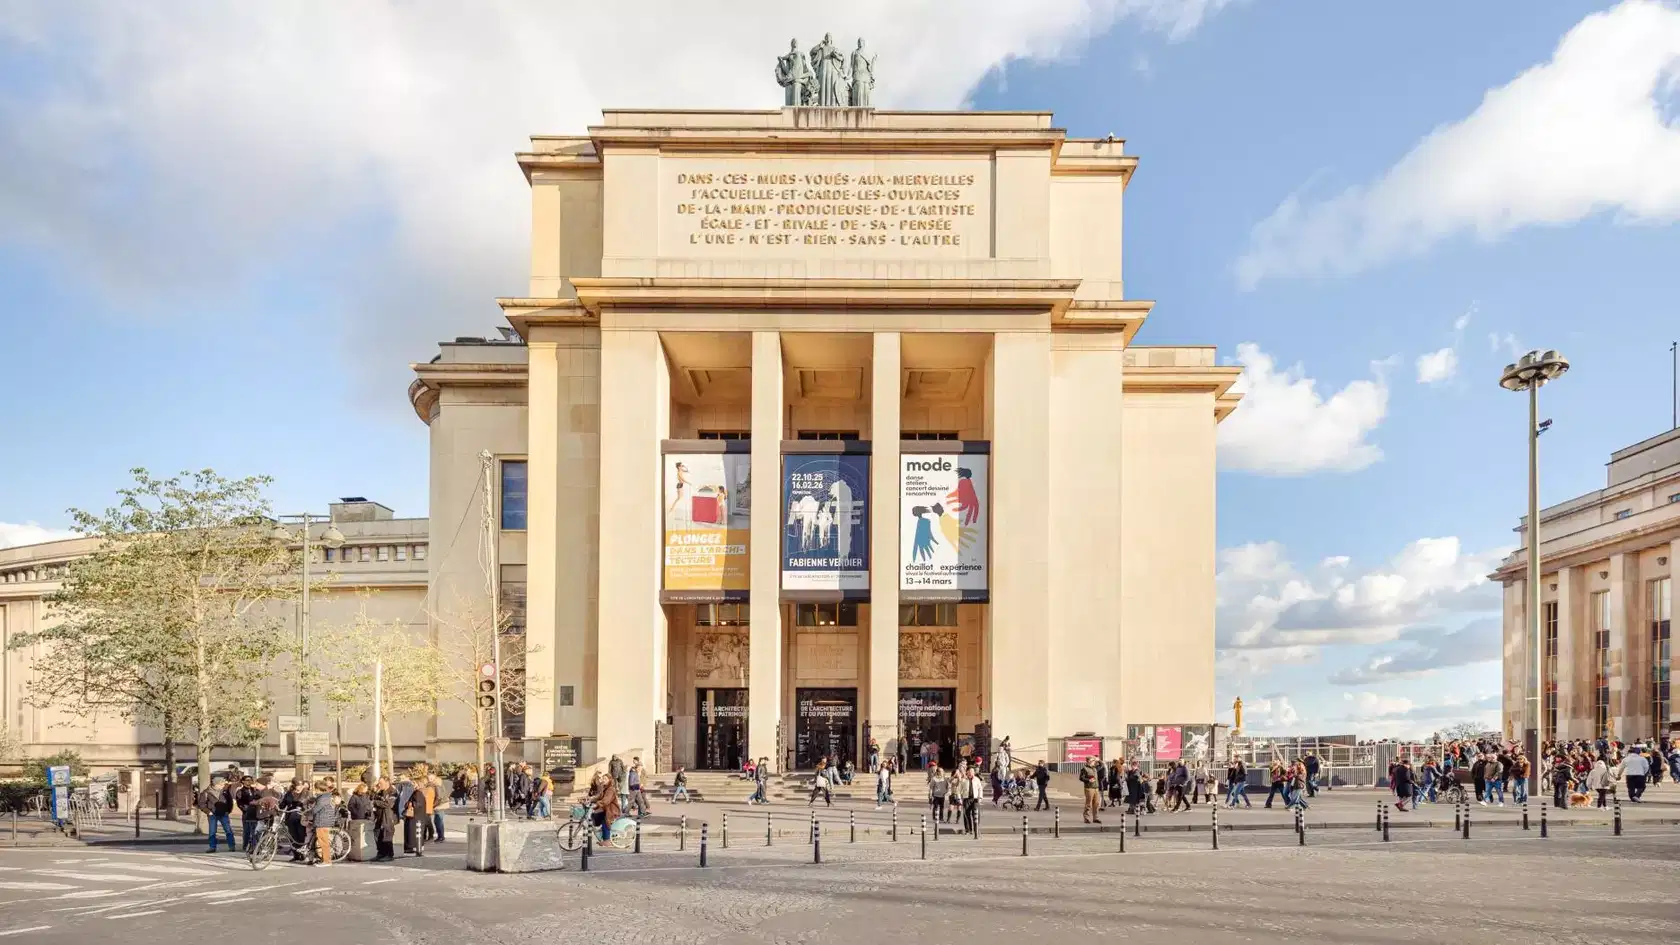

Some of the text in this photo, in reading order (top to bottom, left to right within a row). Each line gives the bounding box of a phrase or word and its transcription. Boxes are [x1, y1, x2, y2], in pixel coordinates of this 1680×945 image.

[678, 173, 975, 186] DANS CES MURS VOUÉS AUX MERVEILLES
[691, 189, 960, 201] J'ACCUEILLE ET GARDE LES OUVRAGES
[677, 204, 975, 216] DE LA MAIN PRODIGIEUSE DE L'ARTISTE
[700, 216, 952, 231] ÉGALE ET RIVALE DE SA PENSÉE
[749, 234, 792, 245] N'EST
[803, 234, 837, 245] RIEN
[848, 234, 887, 245] SANS
[900, 235, 961, 246] L'AUTRE
[906, 456, 952, 472] mode
[791, 473, 824, 481] 22.10.25
[791, 481, 824, 489] 16.02.26
[669, 533, 722, 545] PLONGEZ
[669, 546, 697, 554] DANS
[669, 556, 713, 565] TECTURE
[789, 558, 828, 567] FABIENNE
[905, 563, 934, 571] chaillot
[905, 577, 914, 585] 13
[922, 577, 931, 585] 14
[924, 703, 952, 711] national
